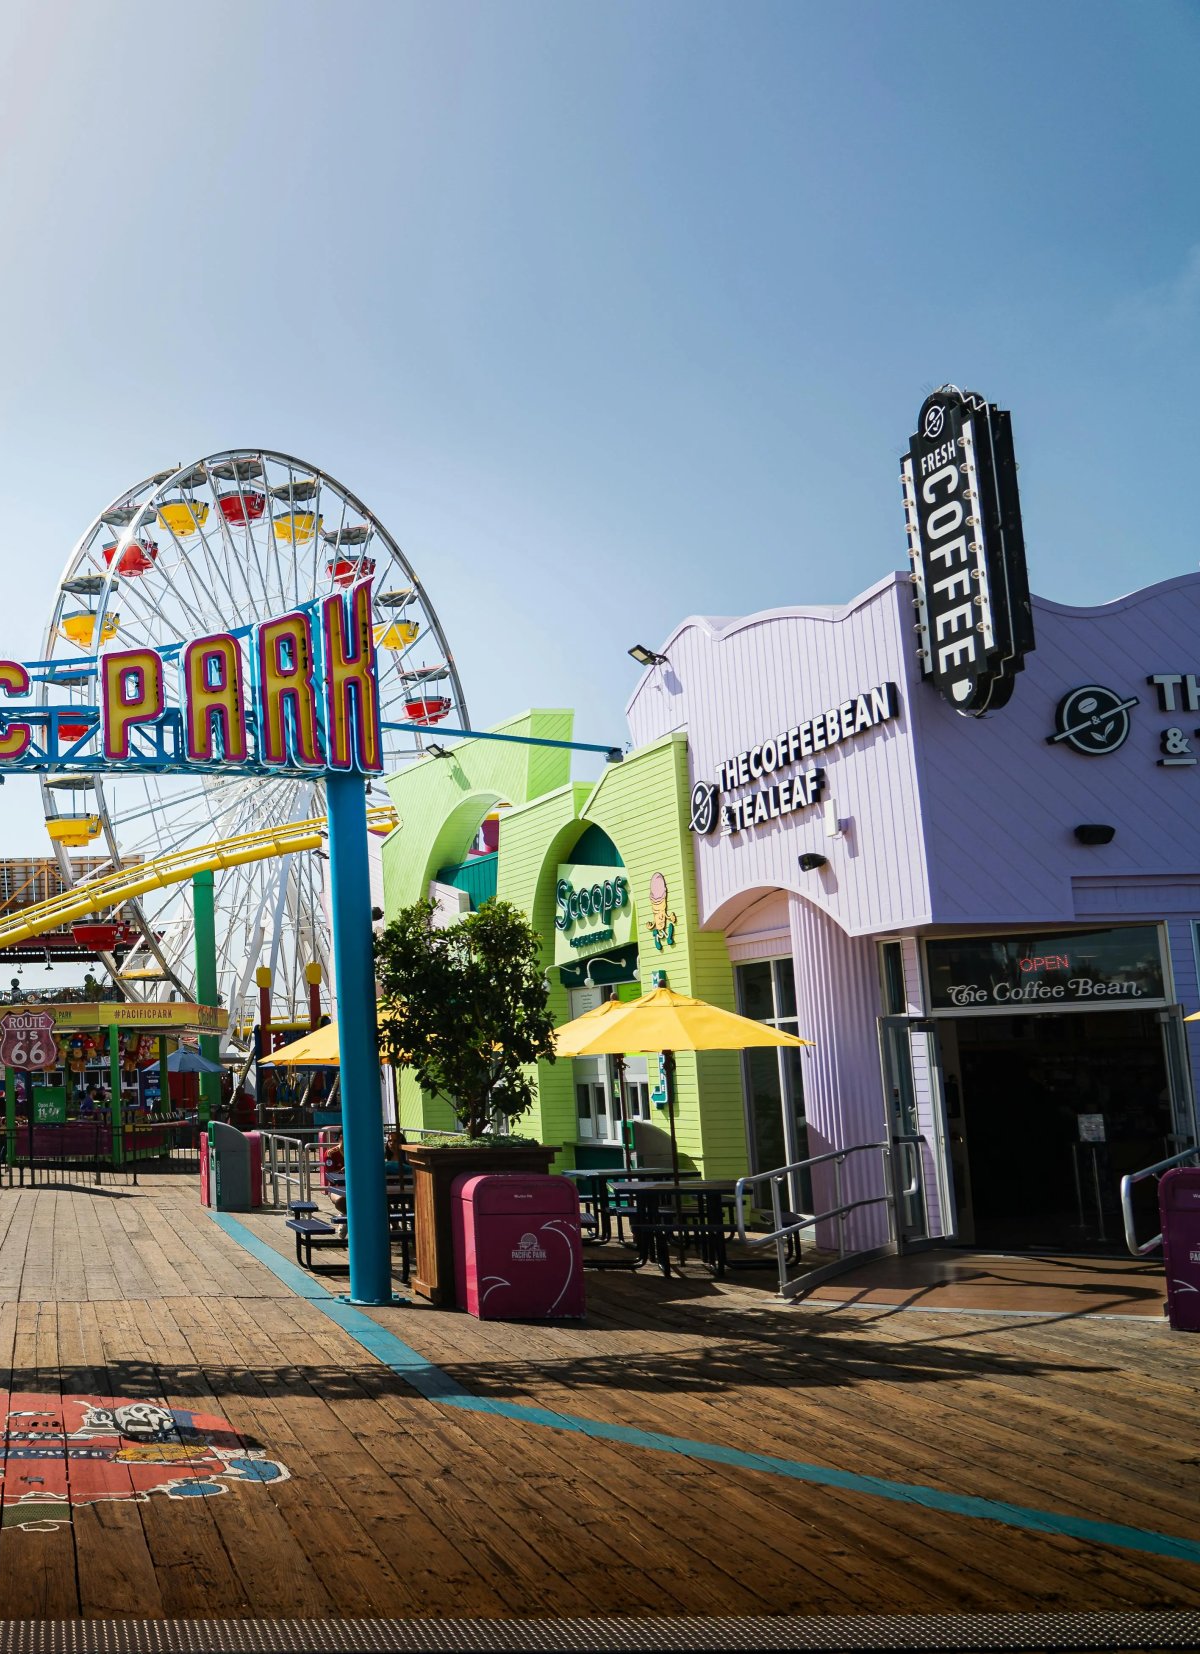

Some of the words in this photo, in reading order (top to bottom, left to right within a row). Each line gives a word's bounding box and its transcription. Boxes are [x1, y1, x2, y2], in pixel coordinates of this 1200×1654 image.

[921, 439, 956, 476] FRESH
[922, 465, 976, 674] COFFEE
[101, 575, 383, 773] PARK
[1152, 674, 1200, 711] TH
[555, 876, 626, 931] Scoops
[1019, 954, 1070, 972] OPEN
[946, 984, 988, 1006] The
[993, 981, 1065, 1001] Coffee
[1067, 978, 1142, 997] Bean
[9, 1017, 46, 1029] ROUTE
[114, 1009, 173, 1019] #PACIFICPARK
[11, 1042, 46, 1065] 66
[511, 1251, 532, 1259] PACIFIC
[532, 1251, 547, 1259] PARK
